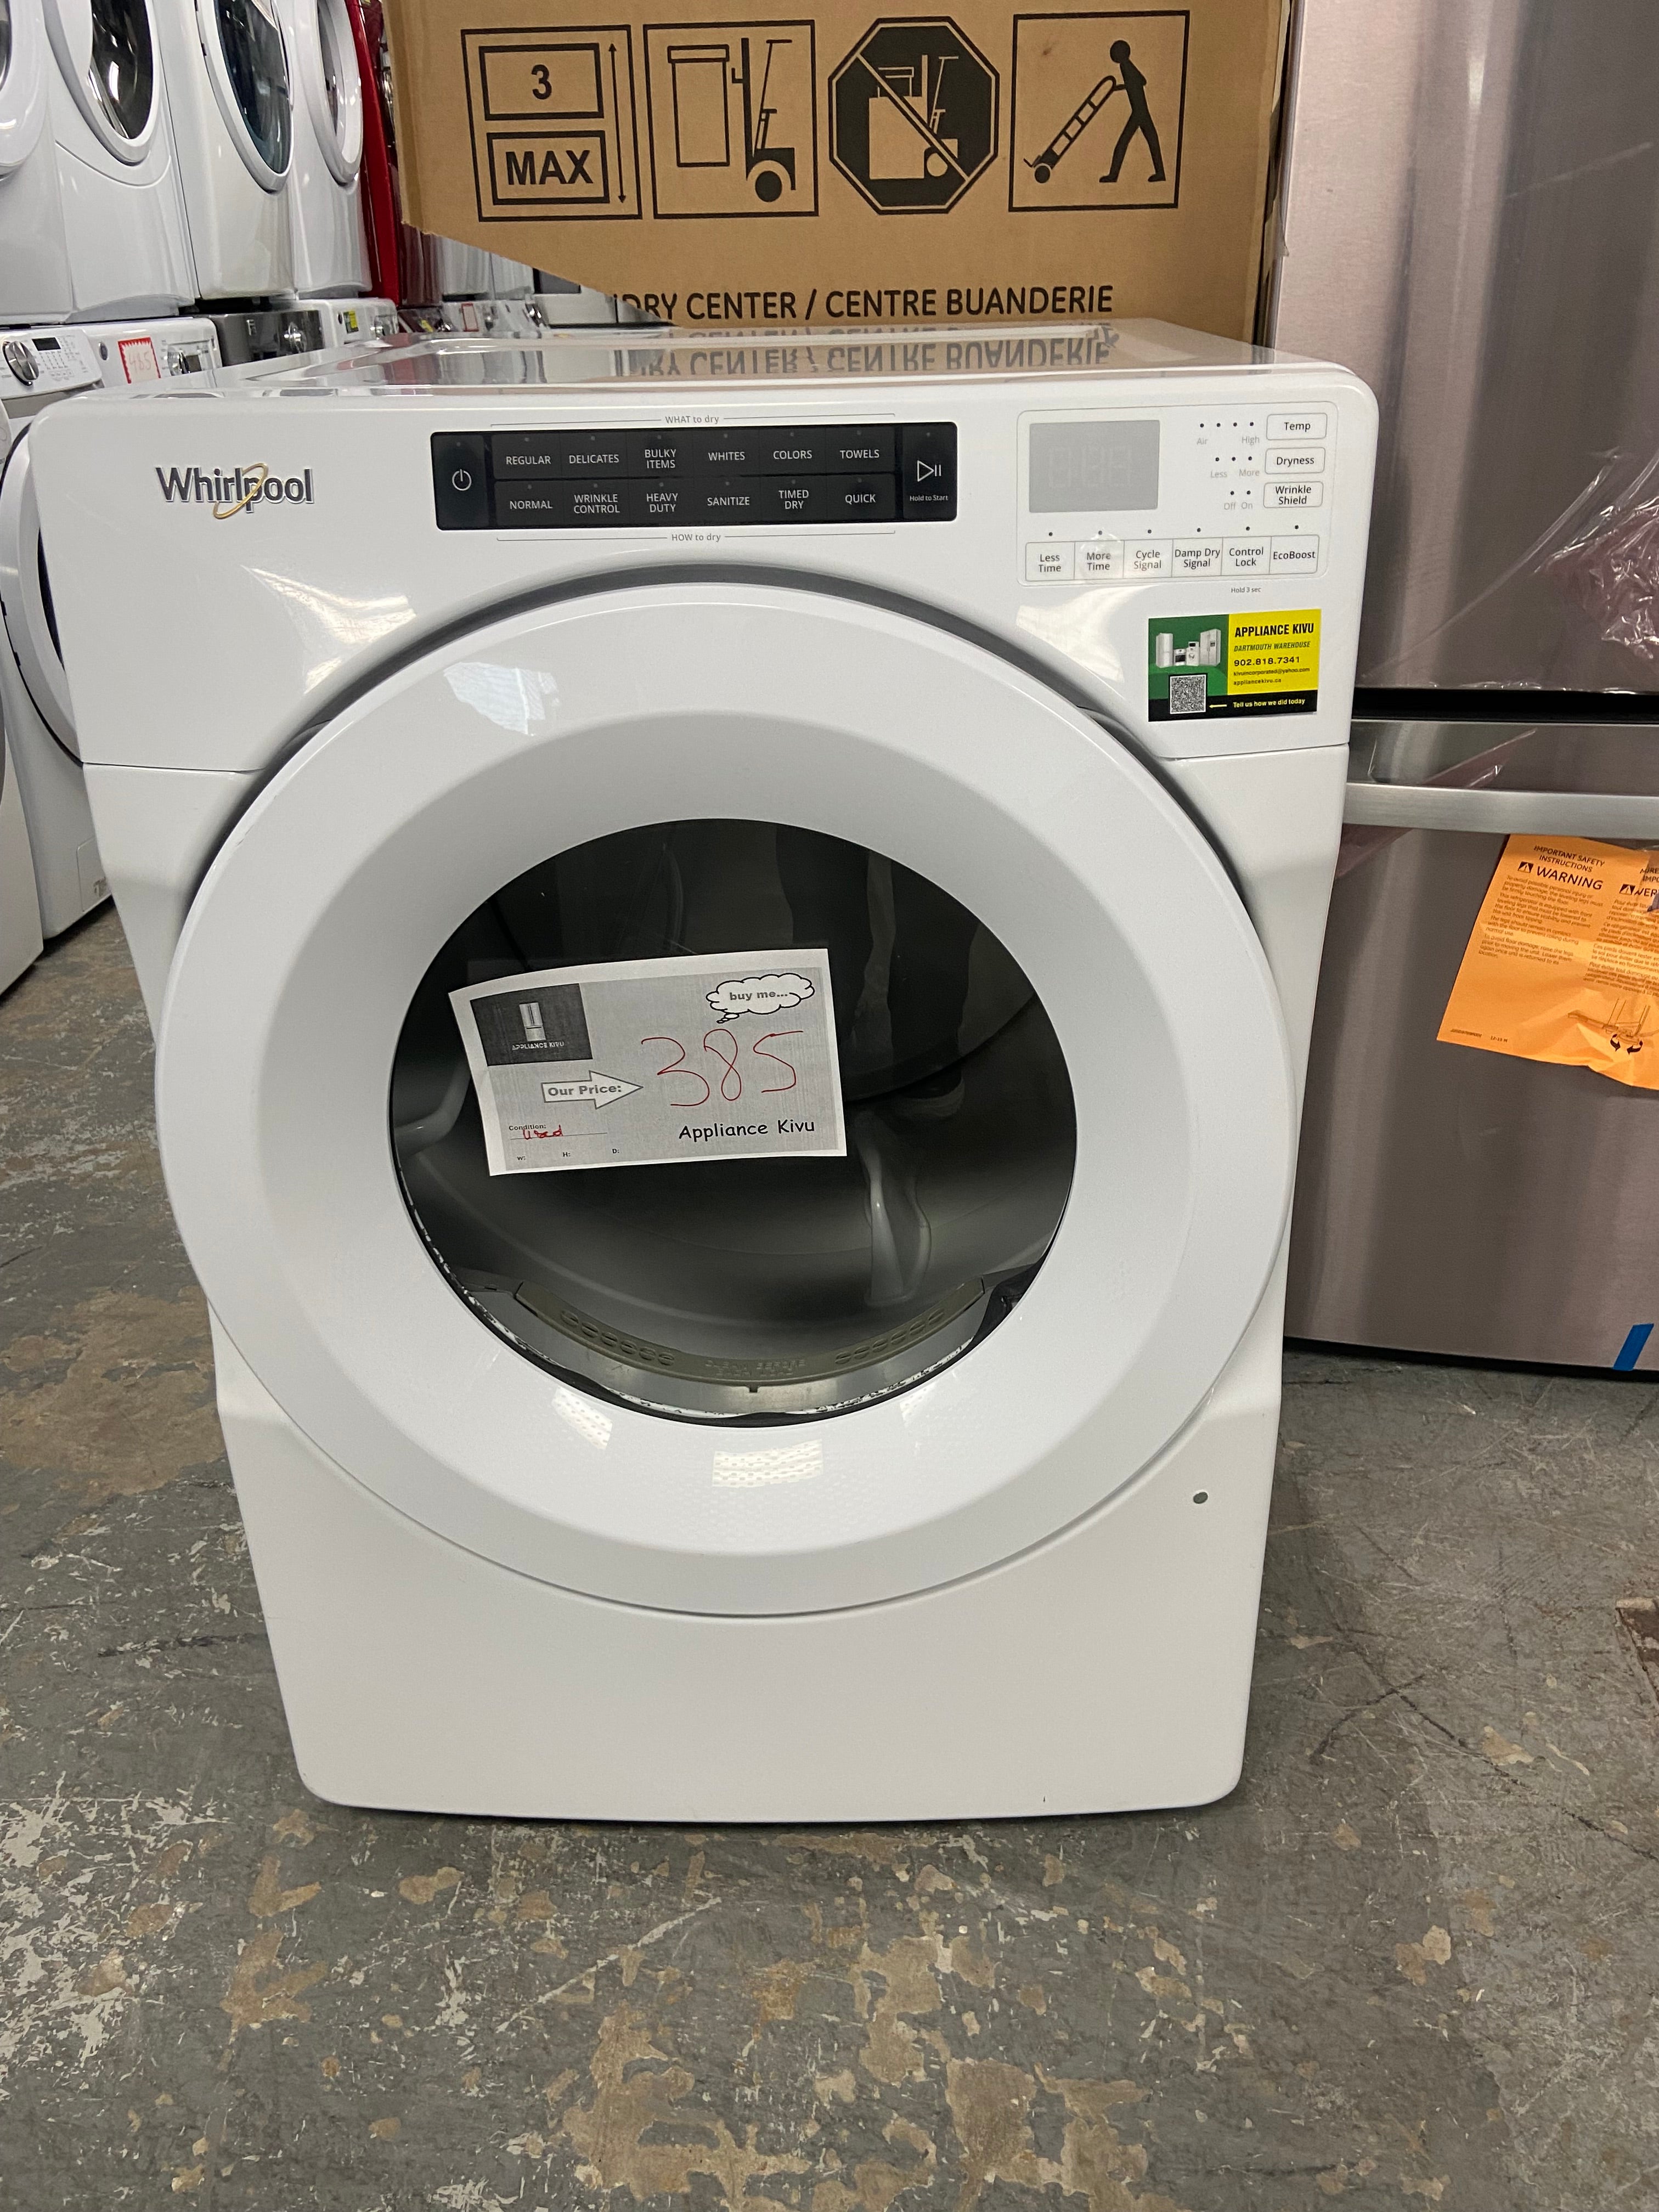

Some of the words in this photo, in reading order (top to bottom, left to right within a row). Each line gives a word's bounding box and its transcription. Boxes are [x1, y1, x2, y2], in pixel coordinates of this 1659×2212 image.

[531, 64, 552, 100] 3
[505, 149, 593, 185] MAX
[686, 293, 797, 319] CENTER
[826, 289, 937, 317] CENTRE
[946, 285, 1114, 315] BUANDERIE
[665, 415, 691, 424] WHAT
[704, 415, 719, 425] dry
[1283, 421, 1311, 432] Temp
[1196, 437, 1209, 445] Air
[1242, 436, 1260, 445] High
[645, 449, 676, 458] BULKY
[708, 452, 745, 461] WHITES
[773, 450, 812, 460] COLORS
[840, 449, 879, 459] TOWELS
[505, 455, 551, 465] REGULAR
[569, 454, 619, 464] DELICATES
[646, 459, 676, 469] ITEMS
[1276, 455, 1316, 467] Dryness
[1210, 470, 1228, 478] Less
[1239, 469, 1260, 477] More
[155, 467, 314, 514] Whirlpool
[778, 490, 809, 499] TIMED
[1274, 485, 1312, 495] Wrinkle
[574, 494, 618, 504] WRINKLE
[646, 493, 679, 503] HEAVY
[707, 496, 750, 506] SANITIZE
[845, 494, 876, 504] QUICK
[1278, 495, 1307, 505] Shield
[509, 501, 552, 510] NORMAL
[574, 504, 620, 514] CONTROL
[650, 504, 676, 513] DUTY
[785, 501, 804, 510] DRY
[1223, 502, 1236, 511] Off
[1241, 501, 1254, 510] On
[706, 533, 721, 543] dry
[1086, 551, 1111, 561] More
[1135, 550, 1161, 560] Cycle
[1174, 548, 1202, 560] Damp
[1204, 547, 1221, 559] Dry
[1229, 546, 1265, 557] Control
[1273, 550, 1316, 561] EcoBoost
[1040, 553, 1060, 562] Less
[1235, 556, 1257, 567] Lock
[1039, 563, 1062, 573] Time
[1087, 561, 1110, 571] Time
[1133, 560, 1162, 571] Signal
[1183, 557, 1211, 569] Signal
[1235, 624, 1289, 637] APPLIANCE
[1293, 623, 1314, 634] KIVU
[1234, 644, 1272, 652] DARTMOUTH
[1274, 641, 1311, 649] WAREHOUSE
[1234, 656, 1300, 667] 902.818.7341
[1534, 845, 1577, 860] IMPORTANT
[1577, 855, 1605, 867] SAFETY
[1539, 855, 1593, 872] INSTRUCTIONS
[1537, 866, 1603, 890] WARNING
[729, 990, 753, 1002] buy
[757, 990, 789, 1000] me...
[641, 1029, 804, 1106] 385
[549, 1087, 574, 1096] Our
[579, 1085, 622, 1094] Price:
[678, 1122, 769, 1141] Appliance
[778, 1119, 815, 1135] Kivu
